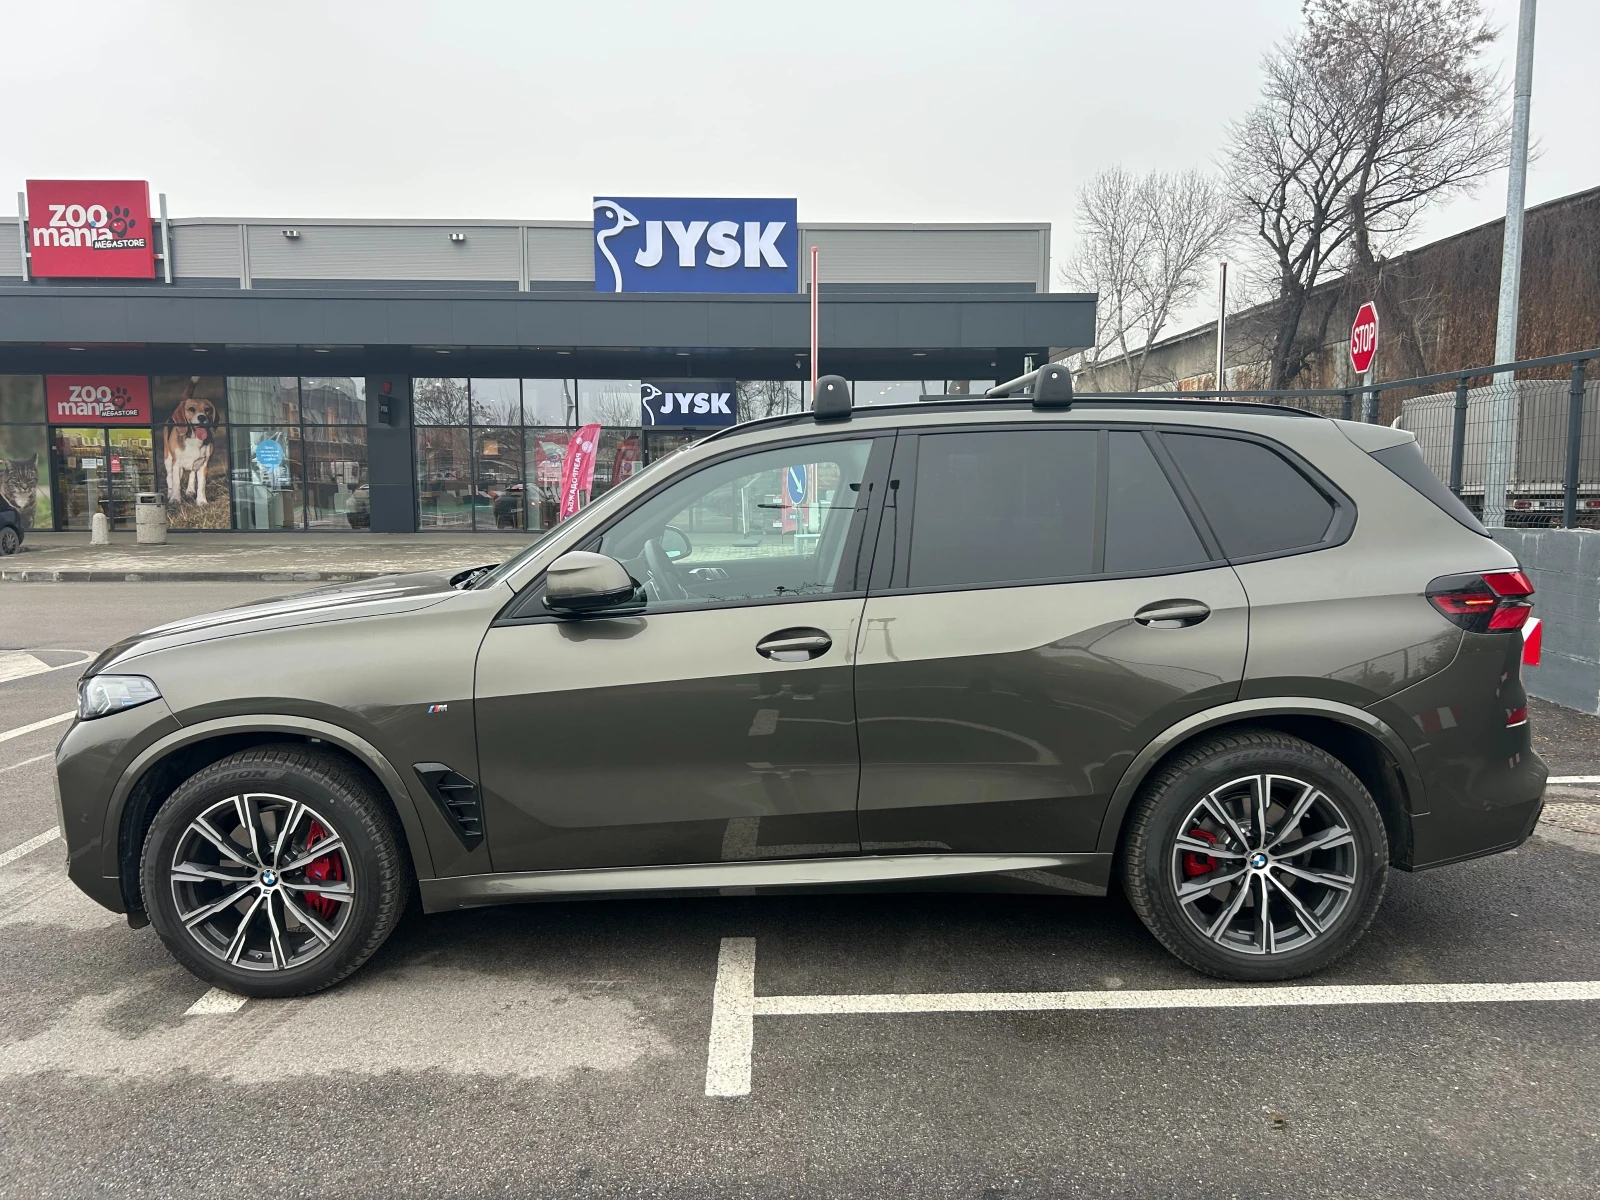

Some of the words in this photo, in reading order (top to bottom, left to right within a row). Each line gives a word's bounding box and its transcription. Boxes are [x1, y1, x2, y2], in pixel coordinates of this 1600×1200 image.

[49, 204, 108, 228] zoo
[33, 225, 113, 247] mania
[94, 238, 145, 249] MEGASTORE
[634, 220, 788, 268] JYSK
[1353, 321, 1375, 355] STOP
[69, 385, 112, 402] zoo
[660, 392, 732, 414] JYSK
[57, 401, 115, 416] mania
[101, 409, 138, 417] MEGASTORE
[1223, 751, 1280, 767] 275/45
